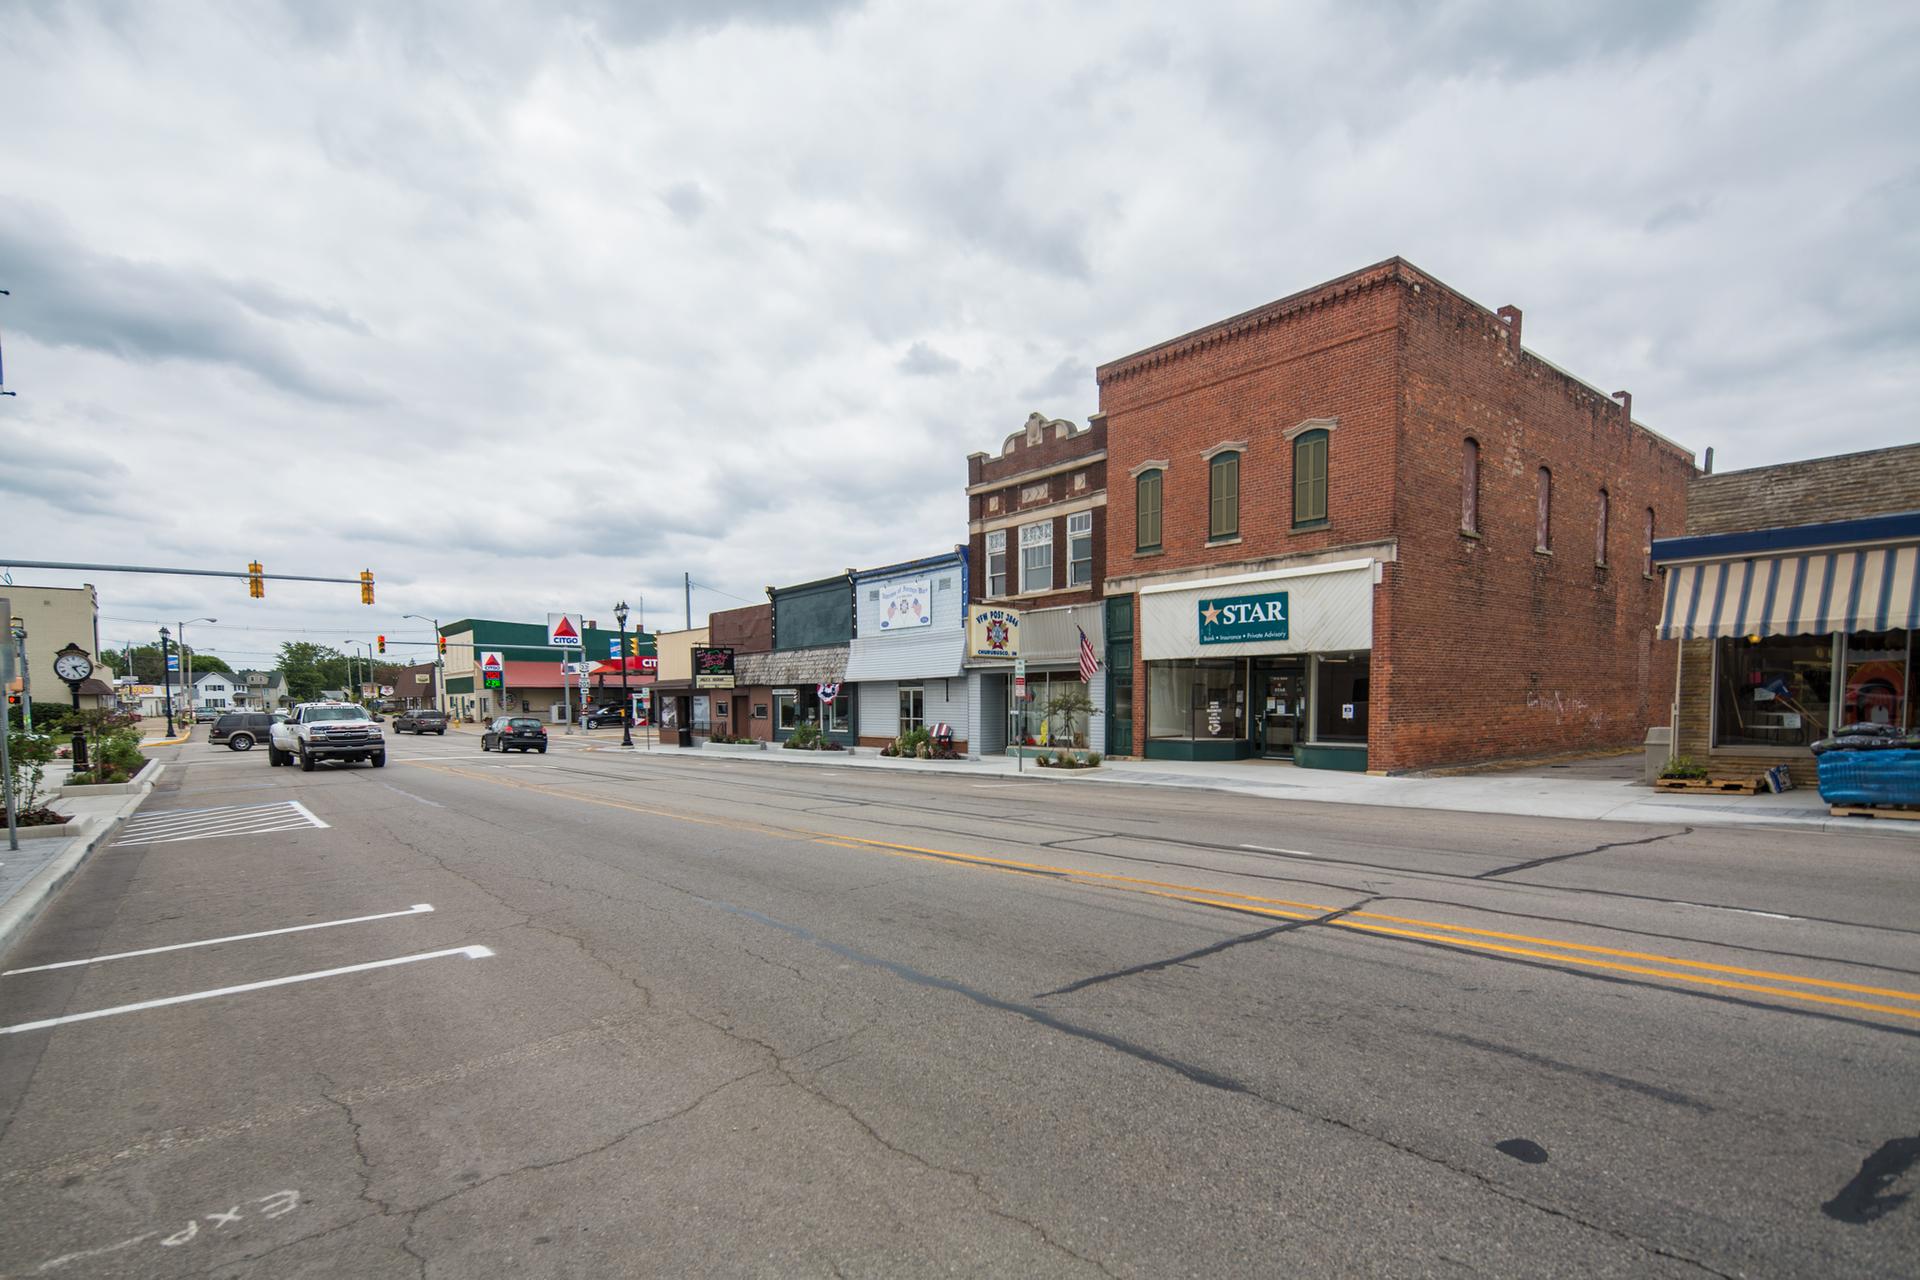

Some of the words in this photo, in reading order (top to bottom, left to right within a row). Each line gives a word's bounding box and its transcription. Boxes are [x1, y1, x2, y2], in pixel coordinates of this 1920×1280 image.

[976, 612, 988, 624] VFW
[990, 610, 1004, 619] POST
[1222, 601, 1286, 625] STAR
